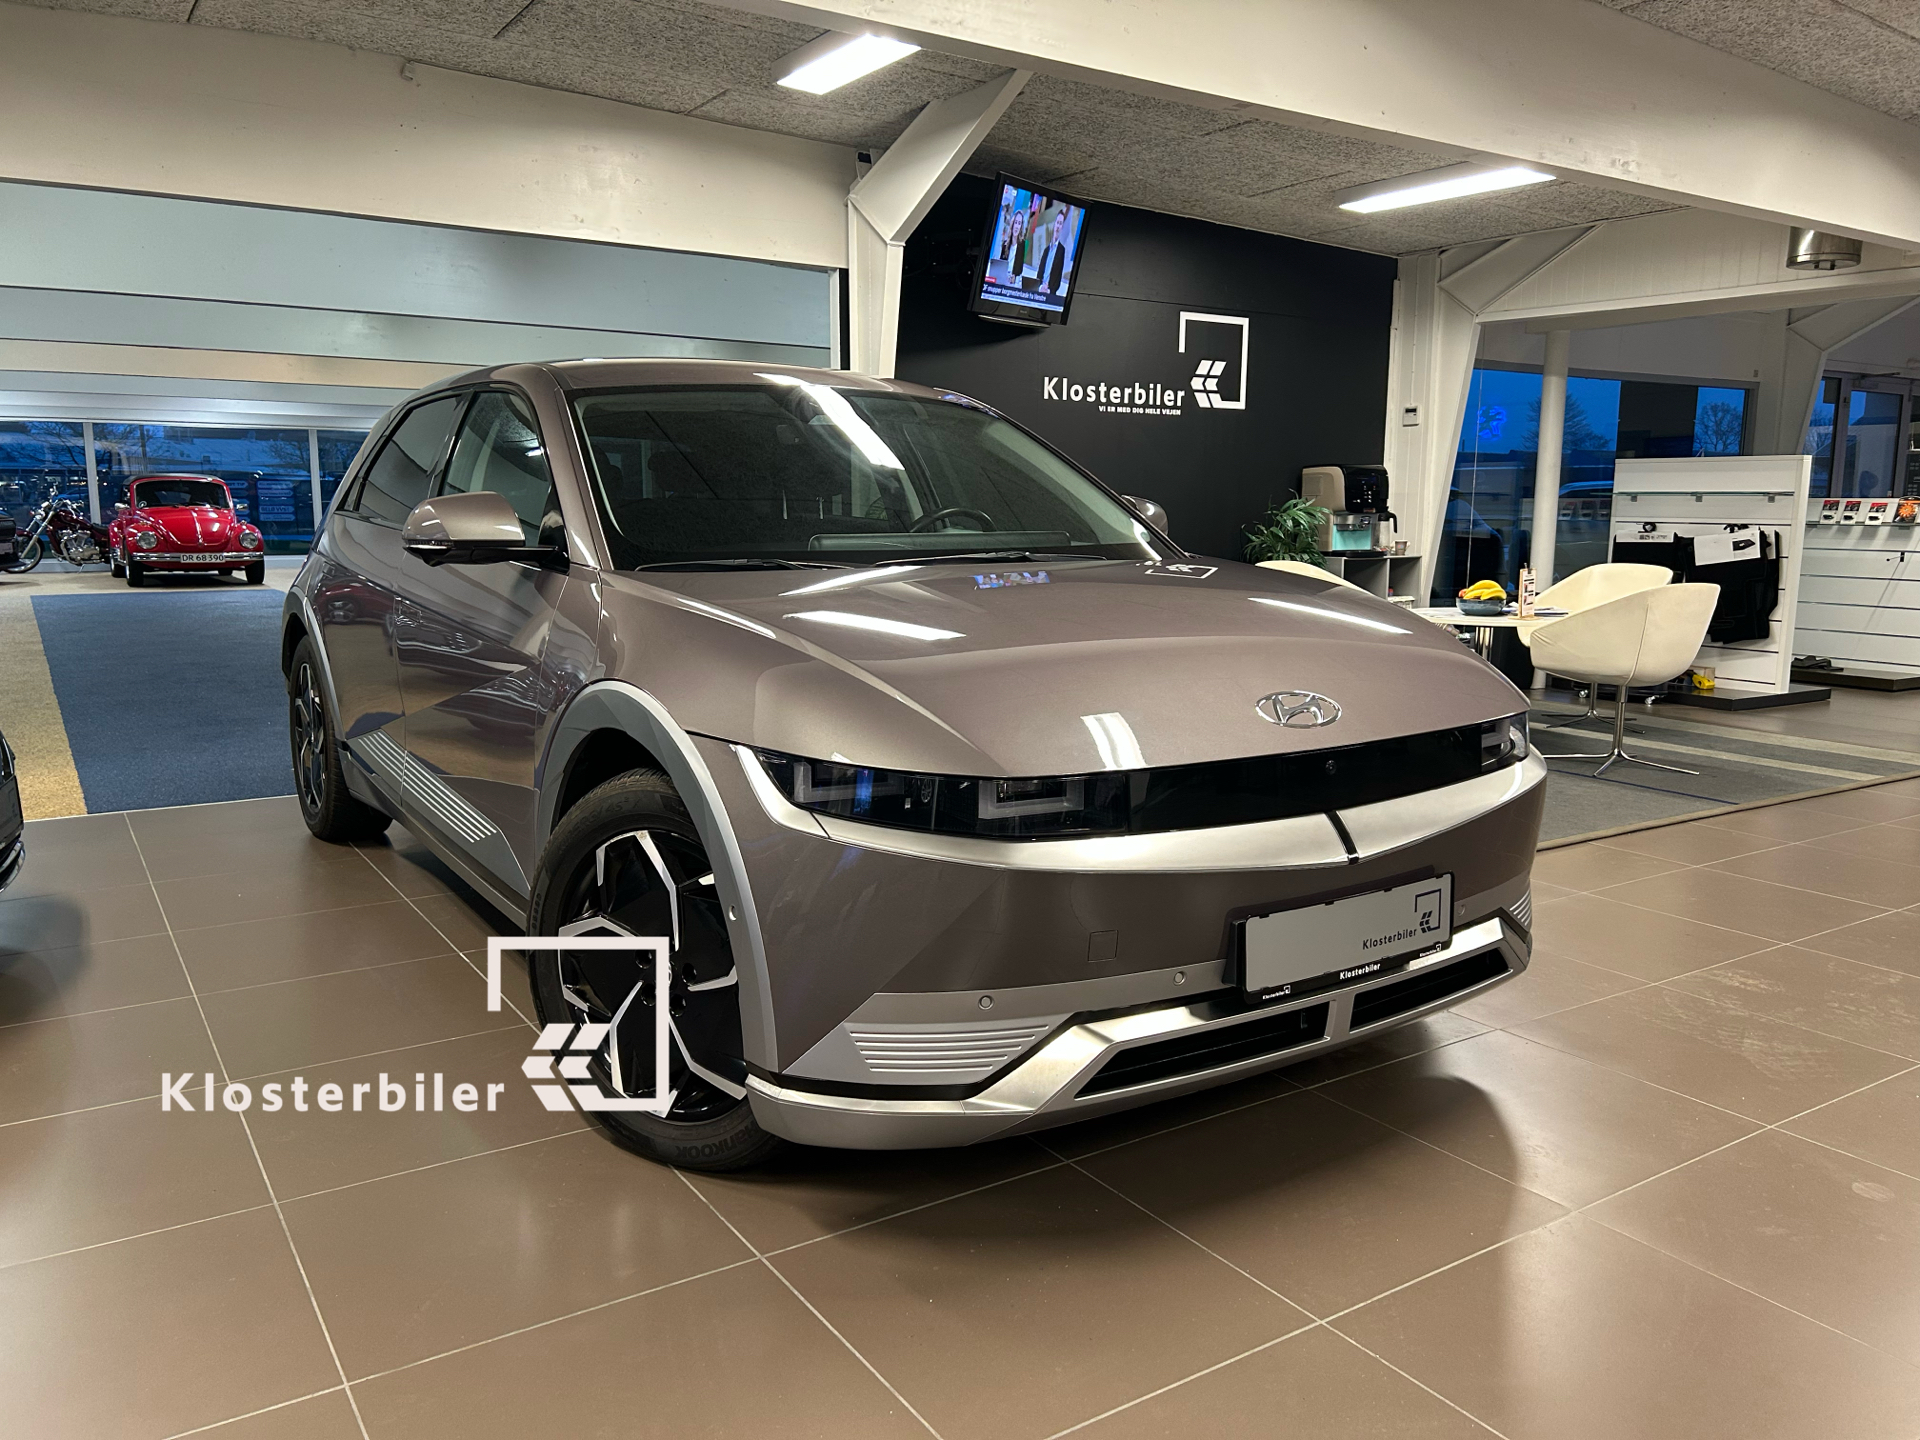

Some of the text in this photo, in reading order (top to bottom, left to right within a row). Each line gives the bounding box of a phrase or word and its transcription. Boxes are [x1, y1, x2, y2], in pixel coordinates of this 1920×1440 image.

[1043, 376, 1185, 407] Klosterbiler
[1161, 408, 1181, 416] VEJEN
[182, 554, 224, 562] DR 68 390
[1362, 928, 1418, 950] Klosterbiler
[1339, 962, 1381, 980] Klosterbiler
